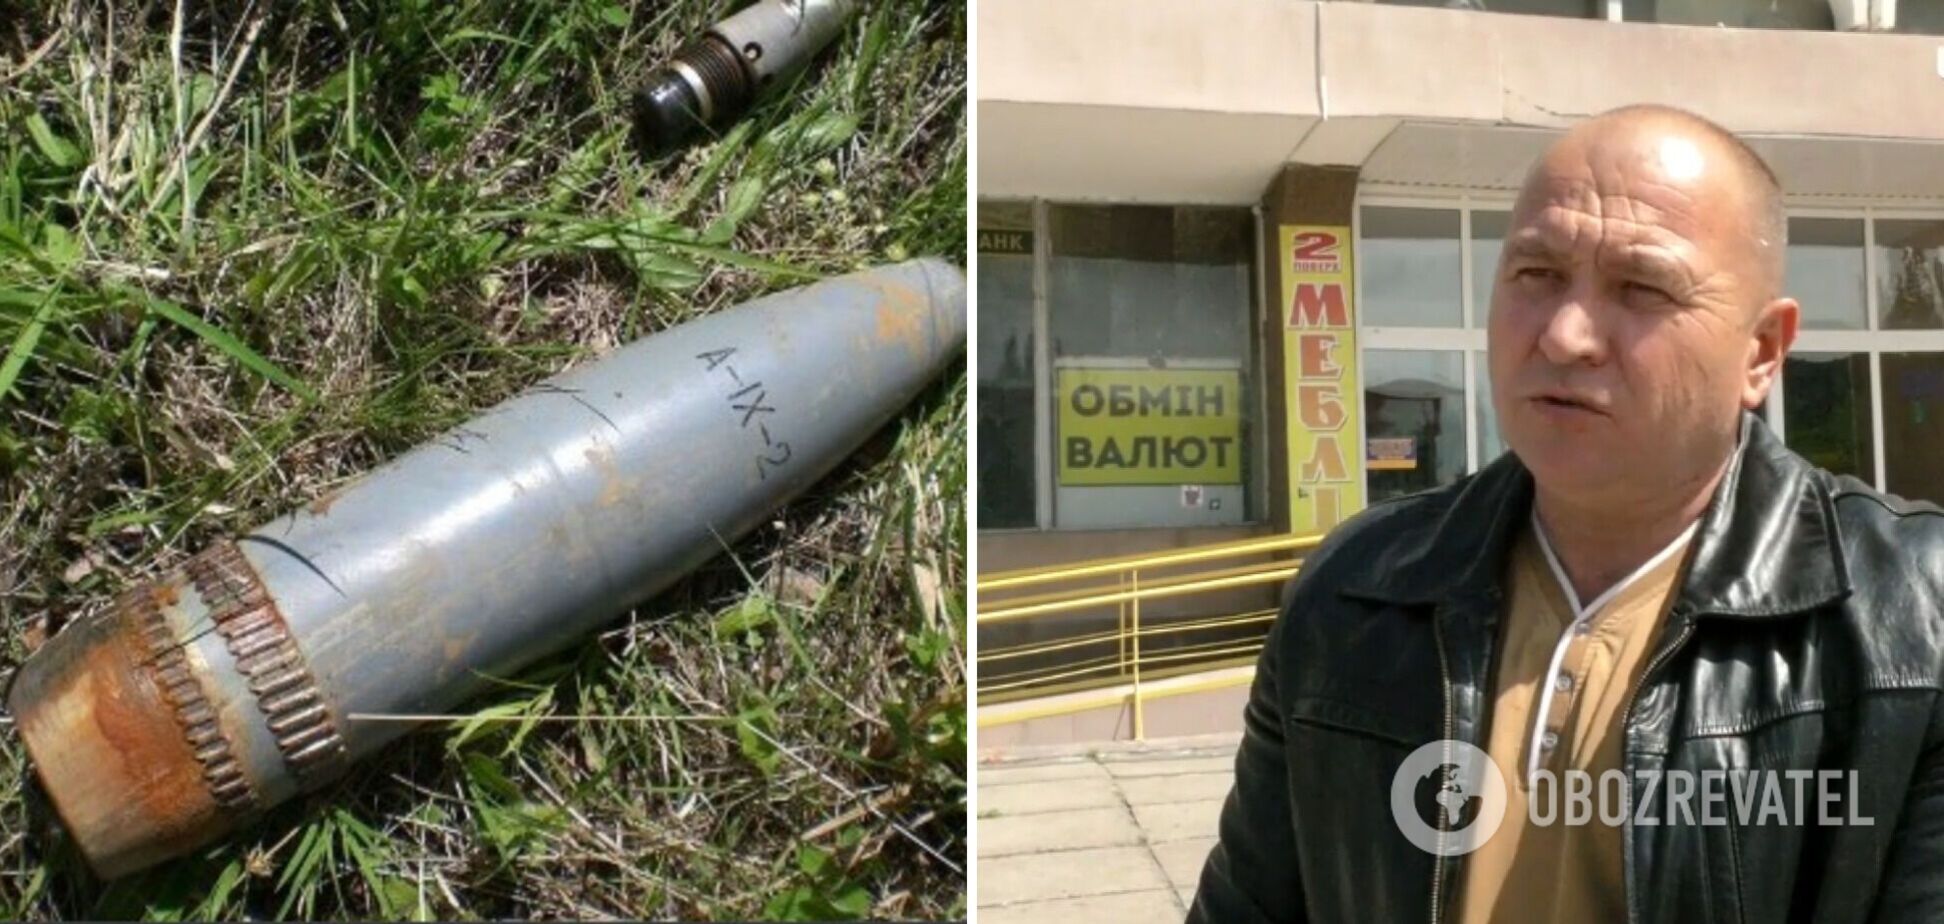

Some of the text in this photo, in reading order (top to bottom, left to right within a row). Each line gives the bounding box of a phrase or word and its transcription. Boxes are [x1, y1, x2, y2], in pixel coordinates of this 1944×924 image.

[1293, 231, 1338, 261] 2
[1071, 384, 1225, 418] ОБМІН
[1066, 437, 1232, 470] ВАЛЮТ
